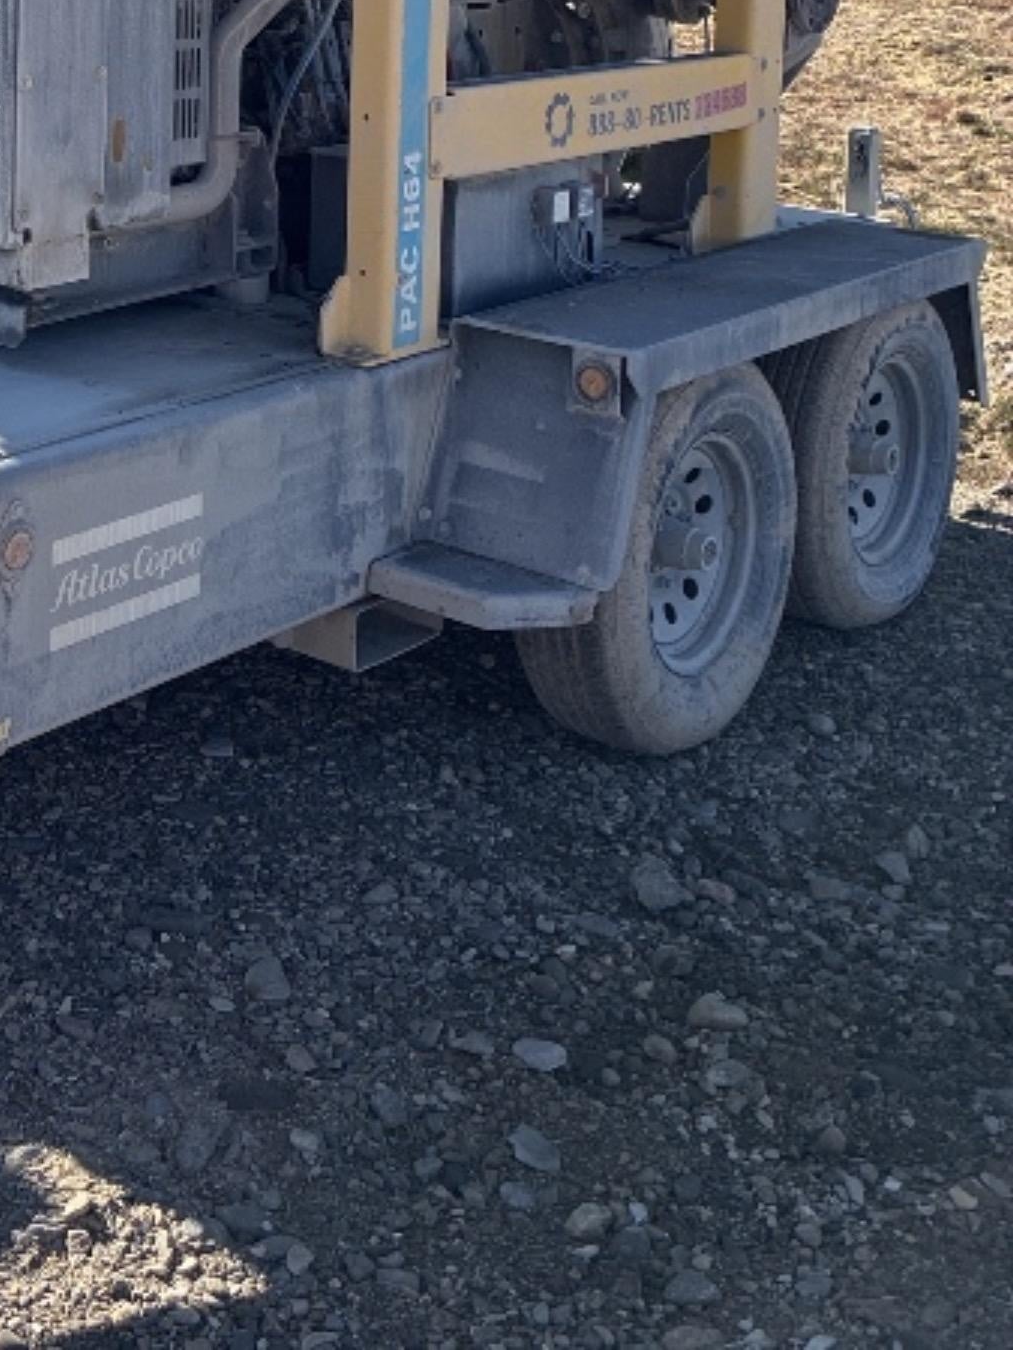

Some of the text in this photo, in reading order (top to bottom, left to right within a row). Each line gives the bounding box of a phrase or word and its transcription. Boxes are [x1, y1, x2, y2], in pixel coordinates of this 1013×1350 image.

[400, 151, 422, 333] PAC H64
[49, 535, 204, 614] Atlas Copco
